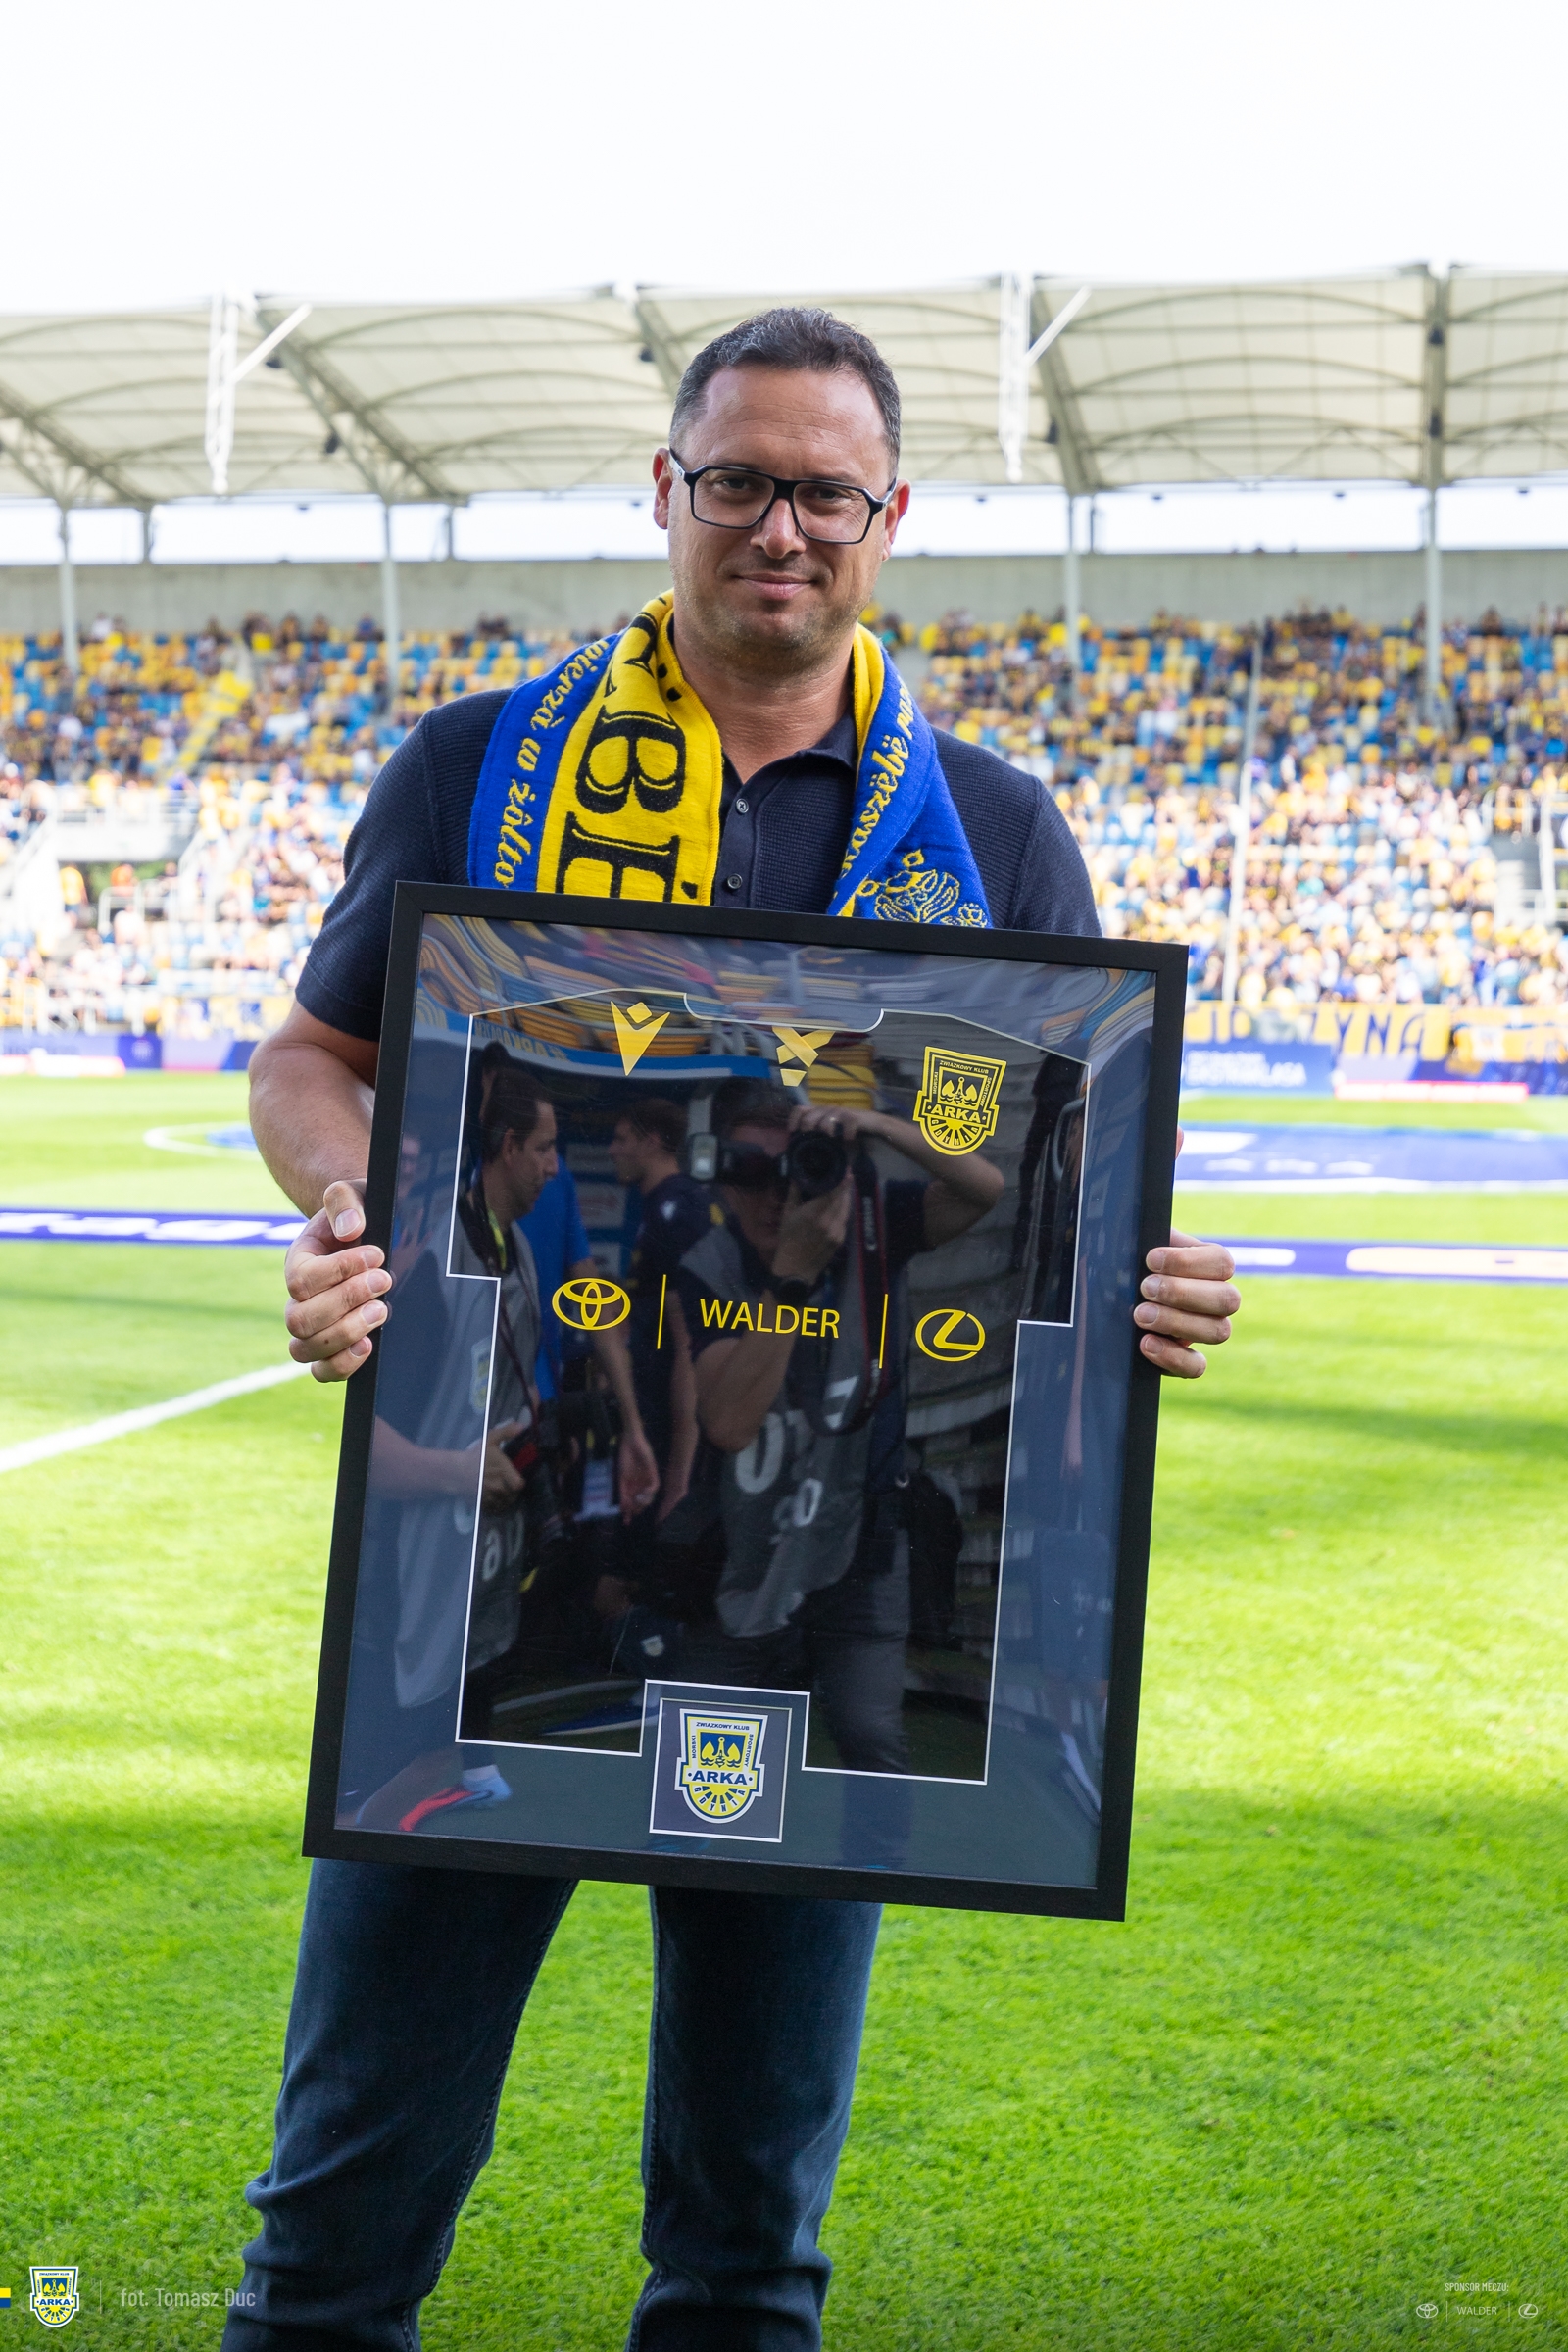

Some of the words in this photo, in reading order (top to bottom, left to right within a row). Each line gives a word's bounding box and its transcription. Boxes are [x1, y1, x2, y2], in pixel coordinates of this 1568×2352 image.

[517, 738, 541, 771] w
[973, 1065, 990, 1075] KLUB
[981, 1077, 992, 1106] SPORTOWY
[931, 1103, 981, 1123] ARKA
[931, 1119, 979, 1146] GDYNIA
[700, 1298, 841, 1339] WALDER
[745, 1734, 754, 1767] SPORTOWY
[692, 1770, 748, 1786] ARKA
[694, 1787, 746, 1812] GDYNIA
